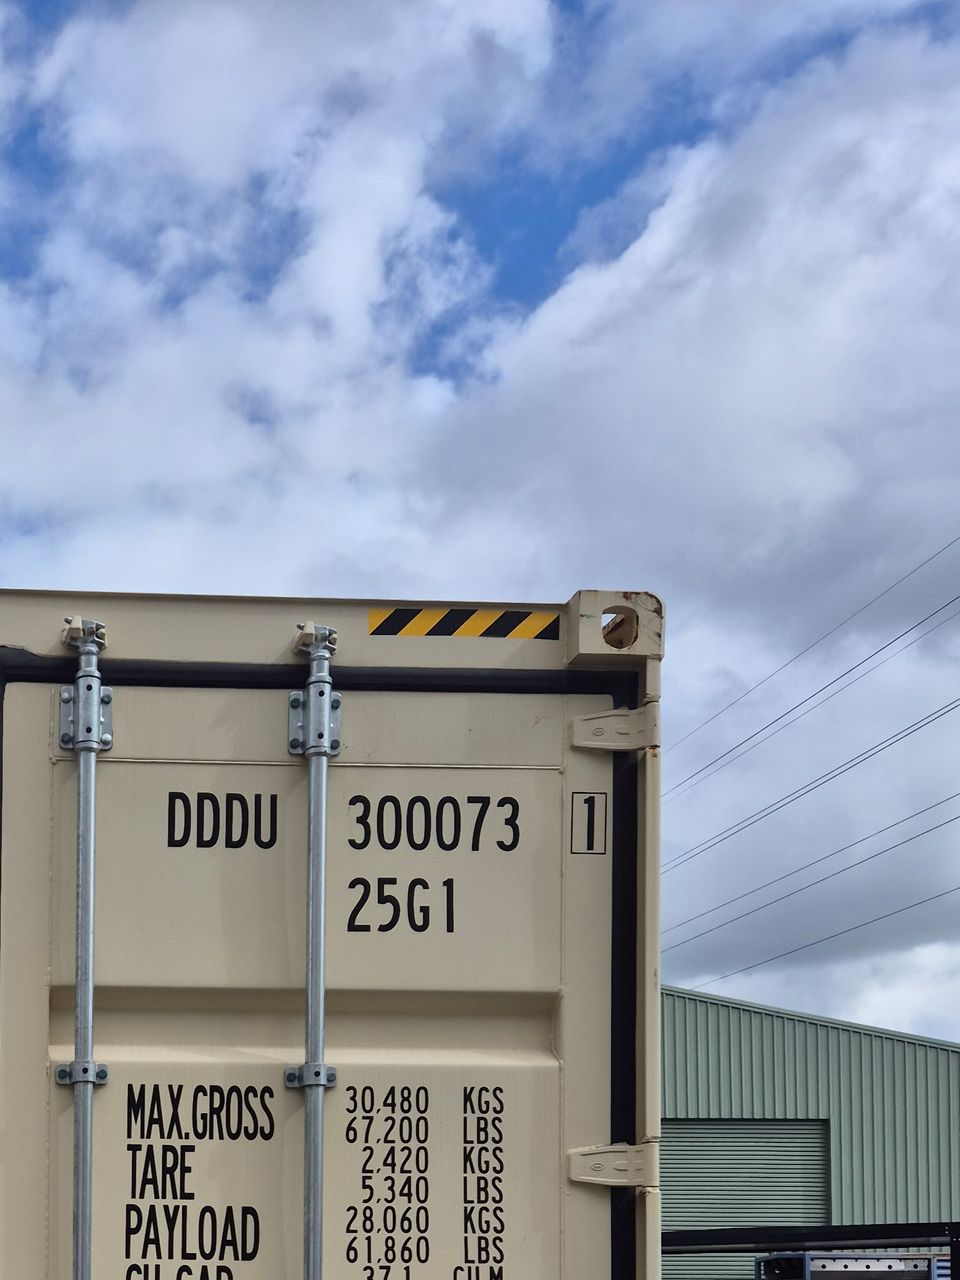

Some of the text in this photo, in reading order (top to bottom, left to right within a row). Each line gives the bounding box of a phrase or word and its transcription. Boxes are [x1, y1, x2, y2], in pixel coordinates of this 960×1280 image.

[167, 791, 596, 852] DDDU 300073 1
[346, 877, 455, 933] 25G1
[127, 1084, 275, 1140] MAX.GROSS
[345, 1085, 504, 1115] 30,480 KGS
[345, 1115, 503, 1144] 67,200 LBS
[126, 1144, 196, 1200] TARE
[361, 1146, 504, 1174] 2,420 KGS
[361, 1176, 504, 1204] 5,340 LBS
[125, 1204, 260, 1261] PAYLOAD
[345, 1206, 505, 1234] 28,060 KGS
[346, 1236, 505, 1264] 61,860 LBS
